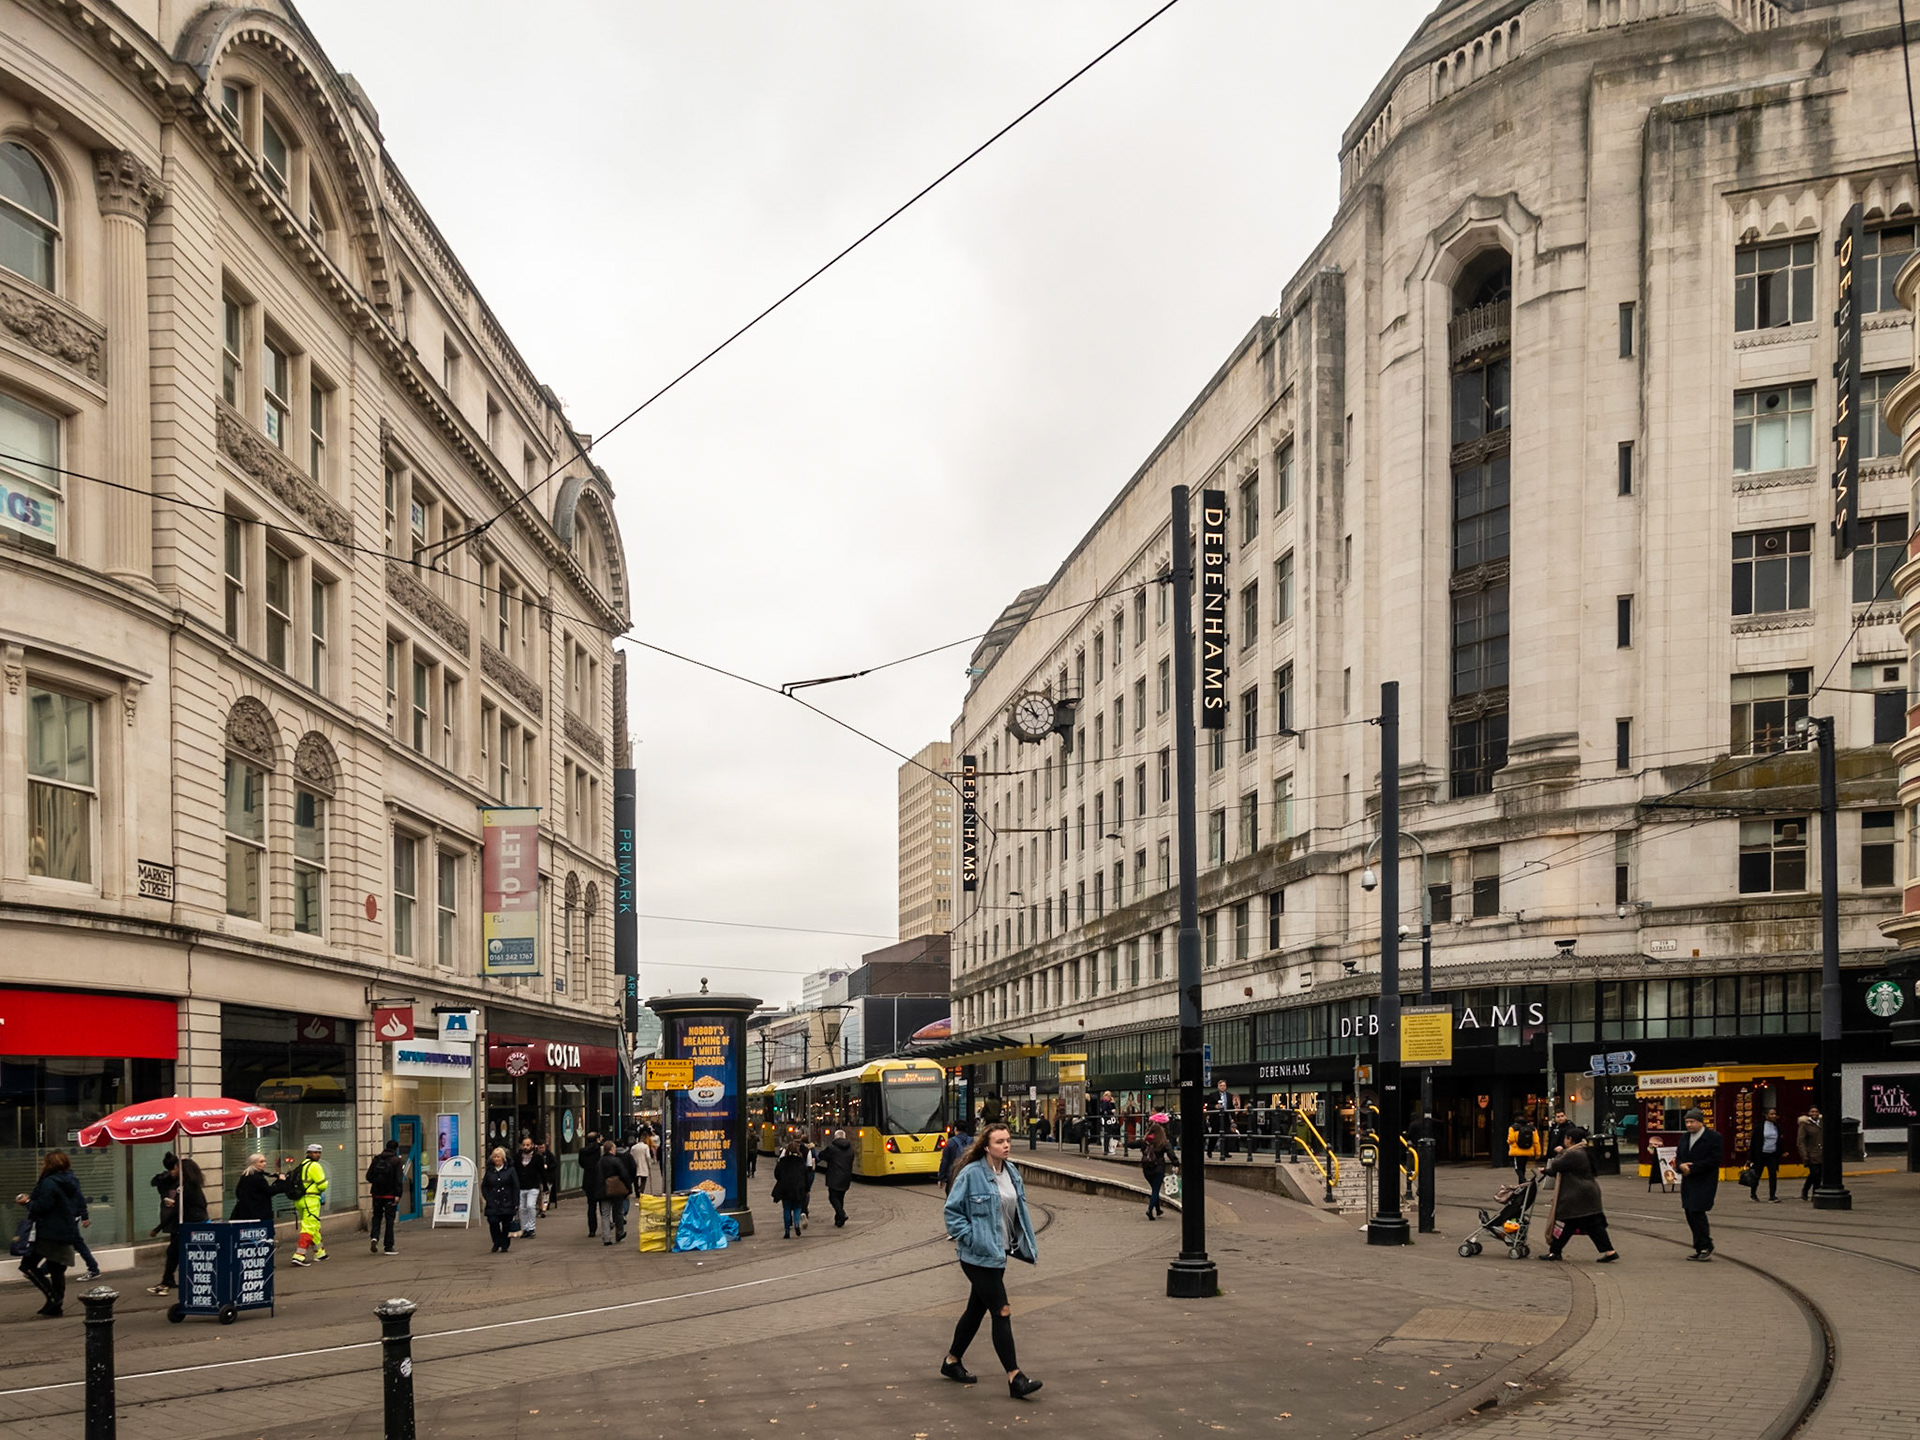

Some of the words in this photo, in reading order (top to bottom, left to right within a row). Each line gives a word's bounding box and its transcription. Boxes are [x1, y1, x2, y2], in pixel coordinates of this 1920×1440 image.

[1836, 234, 1852, 531] DEBENHAMS
[1204, 508, 1223, 709] DEBENHAMS
[963, 765, 976, 882] DEBENHAMS
[501, 829, 521, 869] LET
[138, 864, 173, 884] MARKET
[619, 829, 632, 914] PRIMARK
[140, 879, 171, 898] STREET
[501, 877, 521, 909] TO
[688, 1026, 724, 1036] NOBODY'S
[683, 1036, 720, 1046] DREAMING
[721, 1036, 730, 1045] OF
[508, 1052, 525, 1061] COSTA
[547, 1043, 581, 1070] COSTA
[692, 1046, 697, 1056] A
[699, 1046, 721, 1055] WHITE
[688, 1056, 725, 1066] OUSCOUS
[507, 1065, 528, 1075] COFFEE
[1260, 1063, 1310, 1078] DEBENHAMS
[1144, 1074, 1170, 1085] DEBENHA
[1650, 1077, 1673, 1085] BURGERS
[1691, 1075, 1706, 1083] DOGS
[1299, 1092, 1319, 1111] JUICE
[1871, 1094, 1910, 1107] TALK
[122, 1112, 168, 1123] METRO
[187, 1108, 231, 1119] METRO
[689, 1130, 726, 1140] NOBODY'S
[684, 1140, 721, 1151] DREAMING
[722, 1140, 731, 1149] OF
[693, 1151, 698, 1160] A
[700, 1151, 722, 1160] WHITE
[689, 1160, 726, 1171] COUSCOUS
[191, 1232, 214, 1242] METRO
[241, 1229, 266, 1239] METRO
[188, 1250, 204, 1260] PICK
[206, 1250, 217, 1260] UP
[237, 1248, 256, 1258] PICK
[257, 1246, 269, 1257] UP
[192, 1262, 213, 1272] YOUR
[242, 1258, 265, 1269] YOUR
[193, 1273, 211, 1283] FREE
[243, 1269, 263, 1280] FREE
[192, 1284, 212, 1294] COPY
[242, 1280, 264, 1291] COPY
[192, 1296, 212, 1306] HERE
[242, 1291, 264, 1303] HERE
